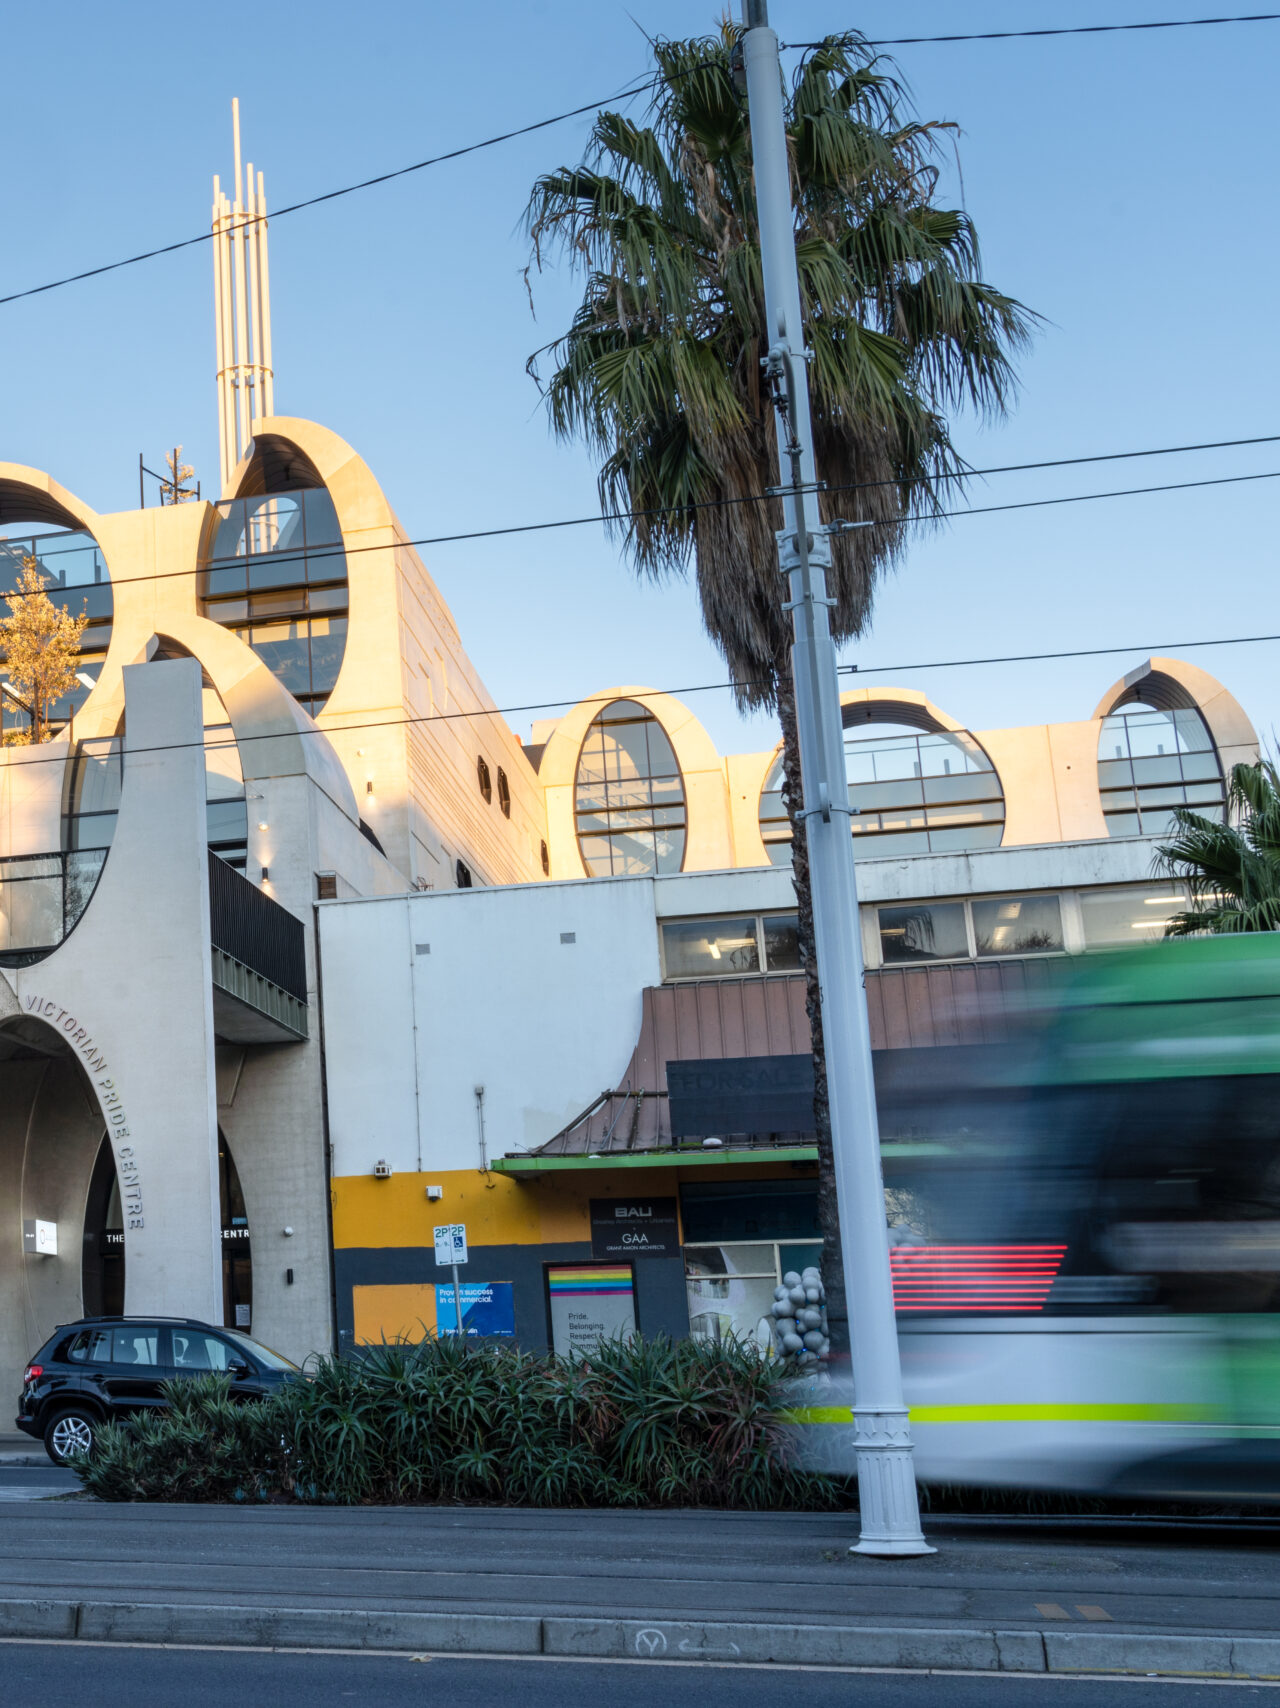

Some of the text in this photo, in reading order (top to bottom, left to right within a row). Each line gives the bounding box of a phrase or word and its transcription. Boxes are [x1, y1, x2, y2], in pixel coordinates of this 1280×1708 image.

[25, 994, 145, 1230] VICTORIAN PRIDE CENTRE
[435, 1227, 448, 1238] 2P
[451, 1226, 464, 1236] 2P
[106, 1234, 125, 1243] THE
[622, 1233, 648, 1243] GAA
